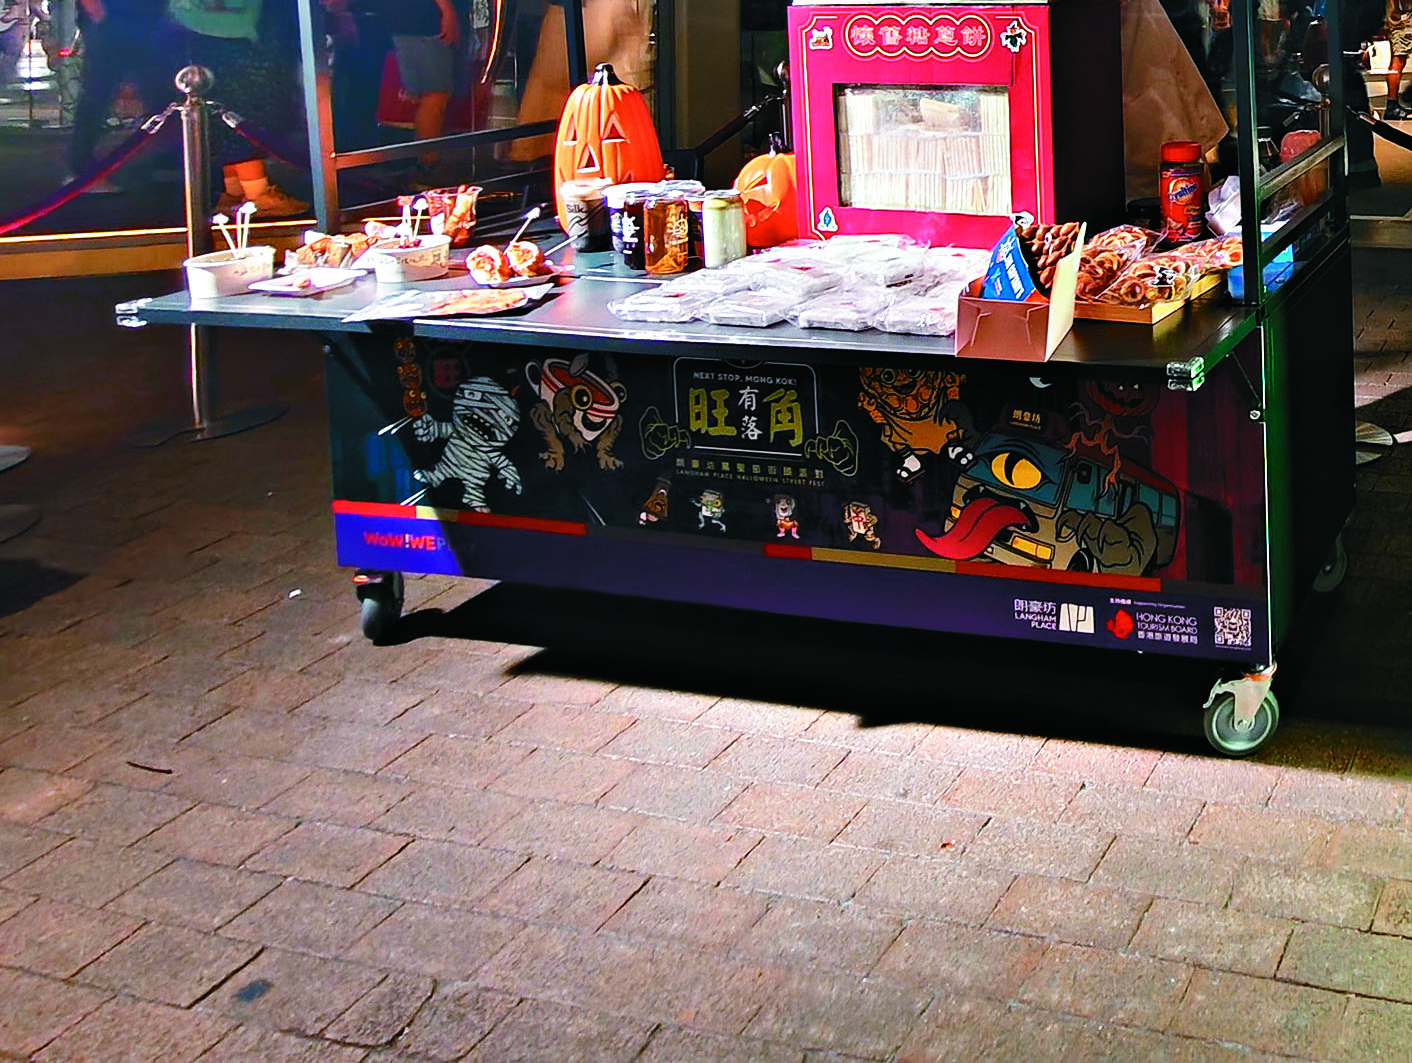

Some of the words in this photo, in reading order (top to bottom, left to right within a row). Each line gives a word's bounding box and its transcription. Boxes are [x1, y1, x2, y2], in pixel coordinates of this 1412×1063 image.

[693, 371, 715, 380] NEXT
[717, 373, 743, 383] STOP,
[745, 375, 774, 384] MONG
[775, 377, 797, 386] KOK!
[689, 387, 737, 436] 旺
[762, 388, 804, 447] 角
[713, 471, 733, 480] PLACE
[1014, 599, 1056, 615] 朗豪坊
[1014, 612, 1057, 623] LANGHAM
[1136, 612, 1166, 624] HONG
[1168, 614, 1198, 626] KONG
[1031, 620, 1057, 630] PLACE
[1137, 622, 1169, 633] TOURISM
[1170, 625, 1198, 635] BOARD
